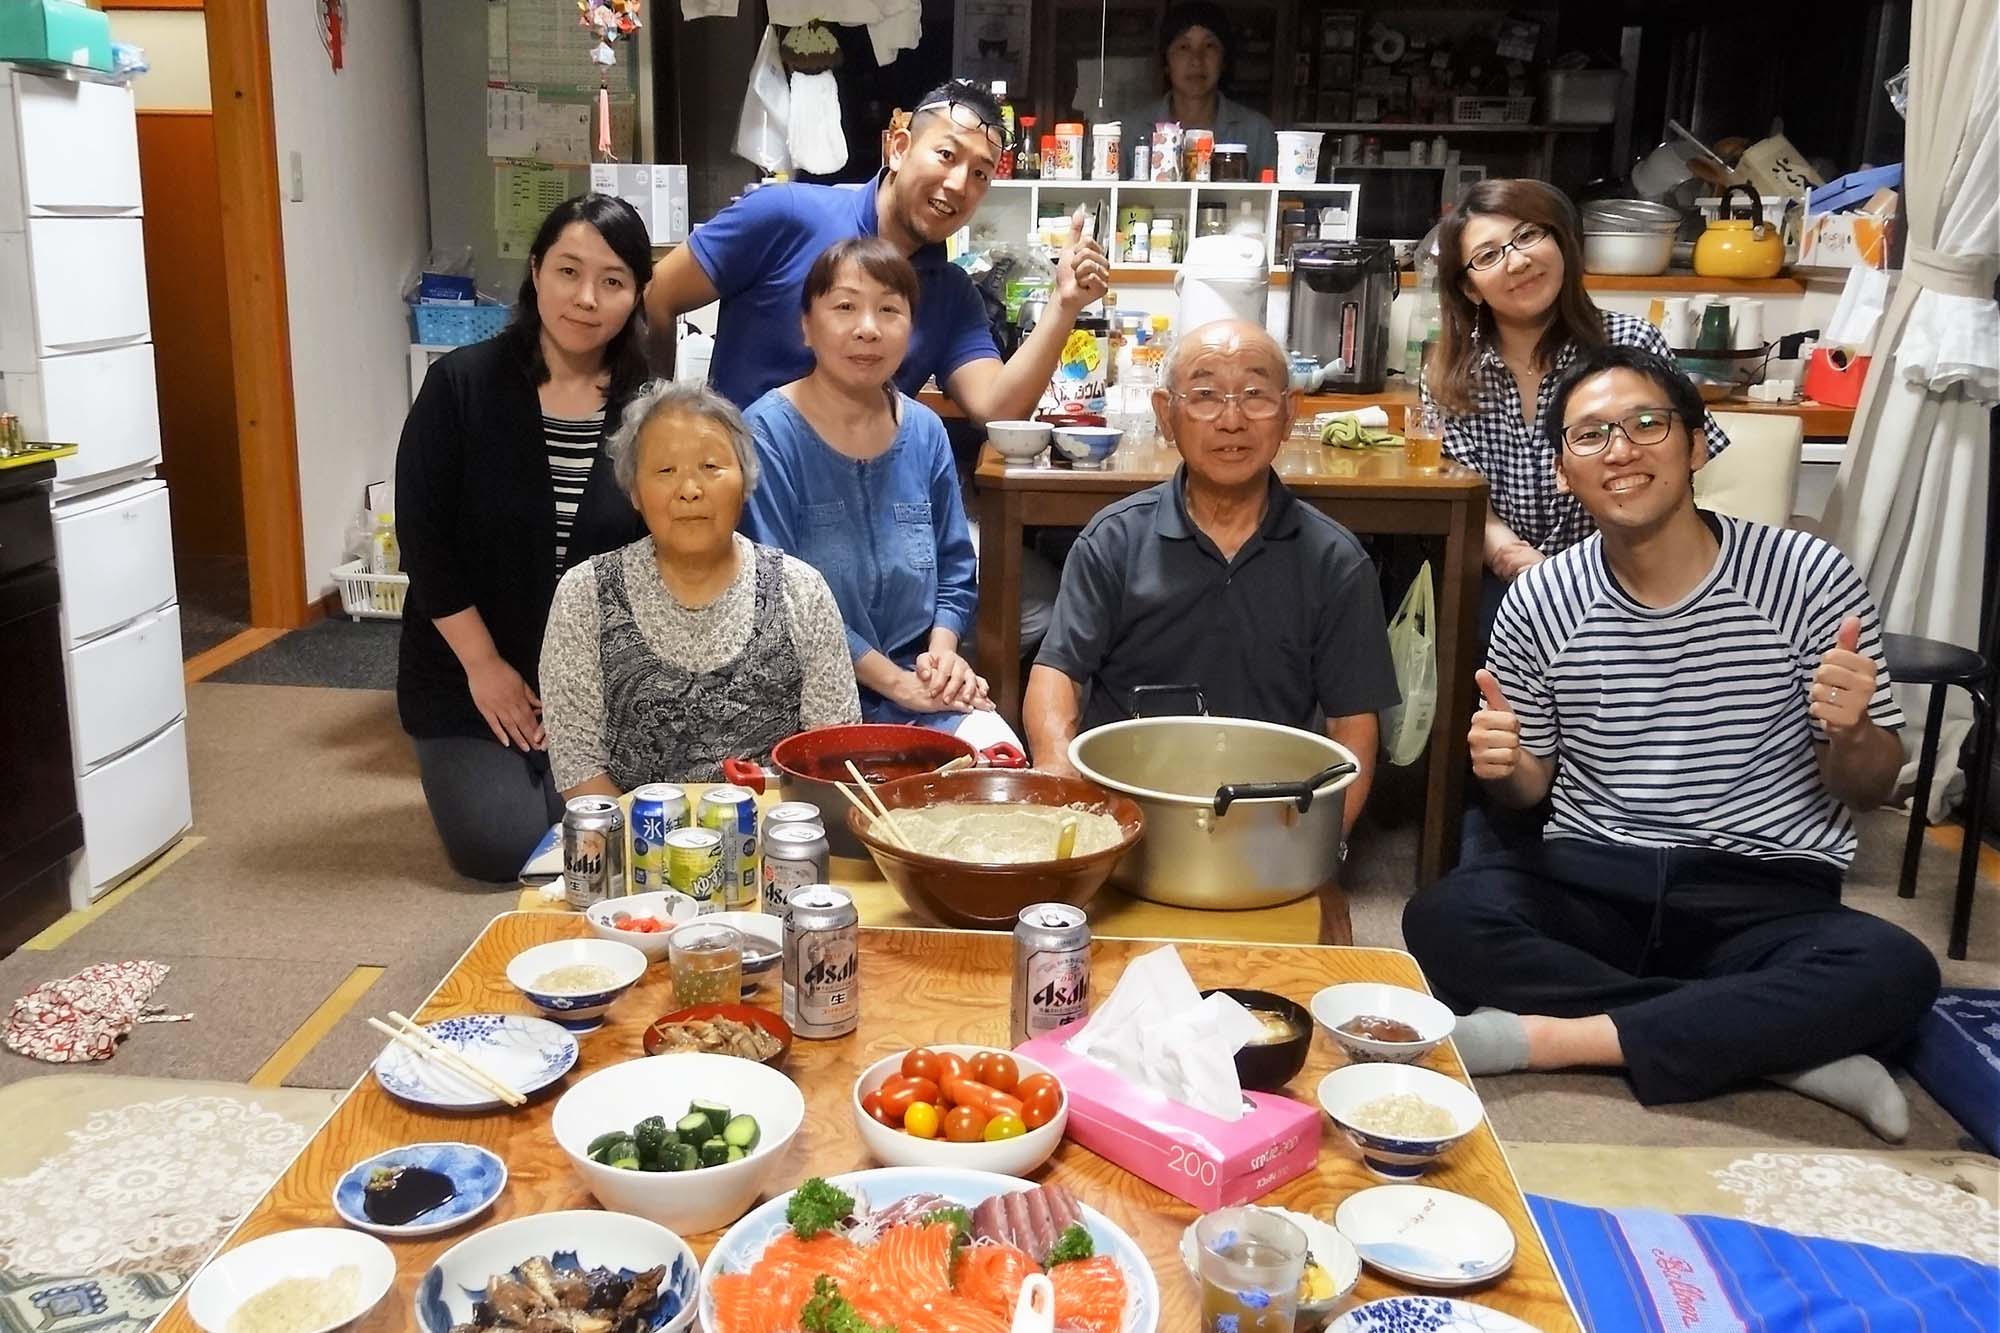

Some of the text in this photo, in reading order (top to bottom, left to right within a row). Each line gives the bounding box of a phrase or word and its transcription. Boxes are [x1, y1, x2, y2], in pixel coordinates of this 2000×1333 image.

[804, 953, 857, 984] Asah
[831, 993, 846, 1005] 生
[1033, 975, 1087, 1007] Asah
[1168, 1145, 1216, 1186] 200
